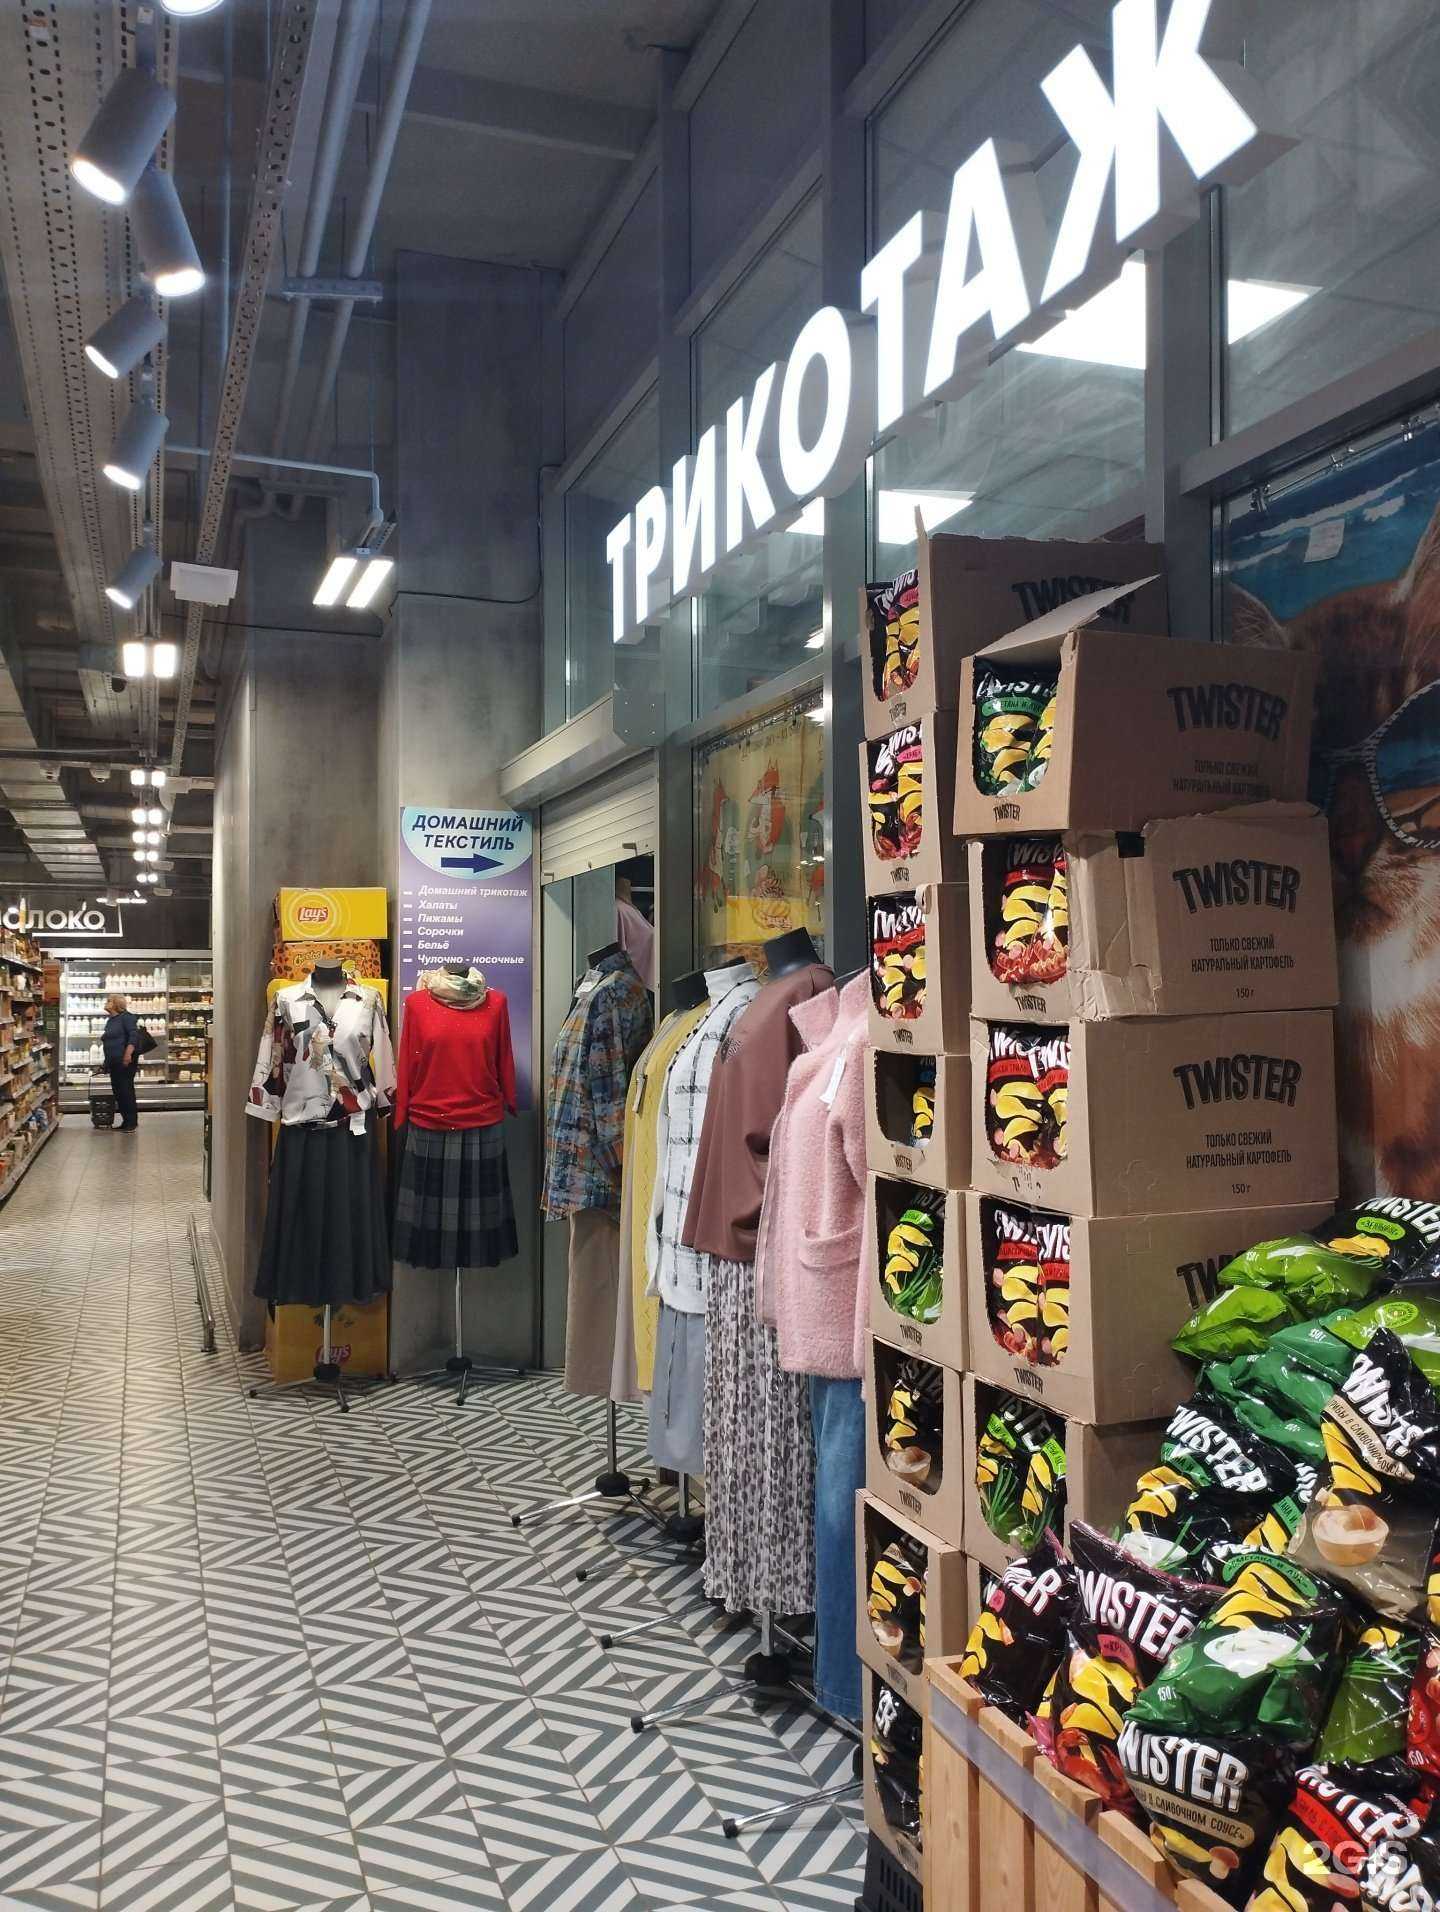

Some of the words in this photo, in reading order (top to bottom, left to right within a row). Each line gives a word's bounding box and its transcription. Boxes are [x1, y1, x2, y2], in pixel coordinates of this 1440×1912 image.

[606, 0, 1257, 645] ТРИКОТАЖ
[1167, 683, 1289, 742] TWISTER
[412, 814, 524, 832] ДОМАШНИЙ
[424, 834, 515, 850] ТЕКСТИЛЬ
[418, 885, 477, 897] Домашний
[480, 887, 528, 898] трикотаж
[1172, 859, 1301, 914] TWISTER
[418, 900, 458, 910] Халаты
[418, 914, 463, 924] Пижамы
[418, 927, 464, 938] Сорочки
[418, 941, 449, 950] Бельё
[1209, 936, 1240, 952] ТОЛЬКО
[1241, 933, 1275, 951] СВЕЖИЙ
[418, 955, 463, 967] Чулочно
[473, 955, 524, 964] носочные
[1191, 955, 1248, 973] НАТУРАЛЬНЫЙ
[1249, 956, 1295, 970] КАРТОФЕЛЬ
[1173, 1054, 1302, 1110] TWISTER
[1206, 1132, 1236, 1148] ТОЛЬКО
[1238, 1129, 1272, 1146] СВЕЖИЙ
[1186, 1150, 1245, 1168] НАТУРАЛЬНЫЙ
[1247, 1150, 1292, 1165] КАРТОФЕЛЬ
[1155, 1796, 1207, 1827] СЛИВОЧНОМ
